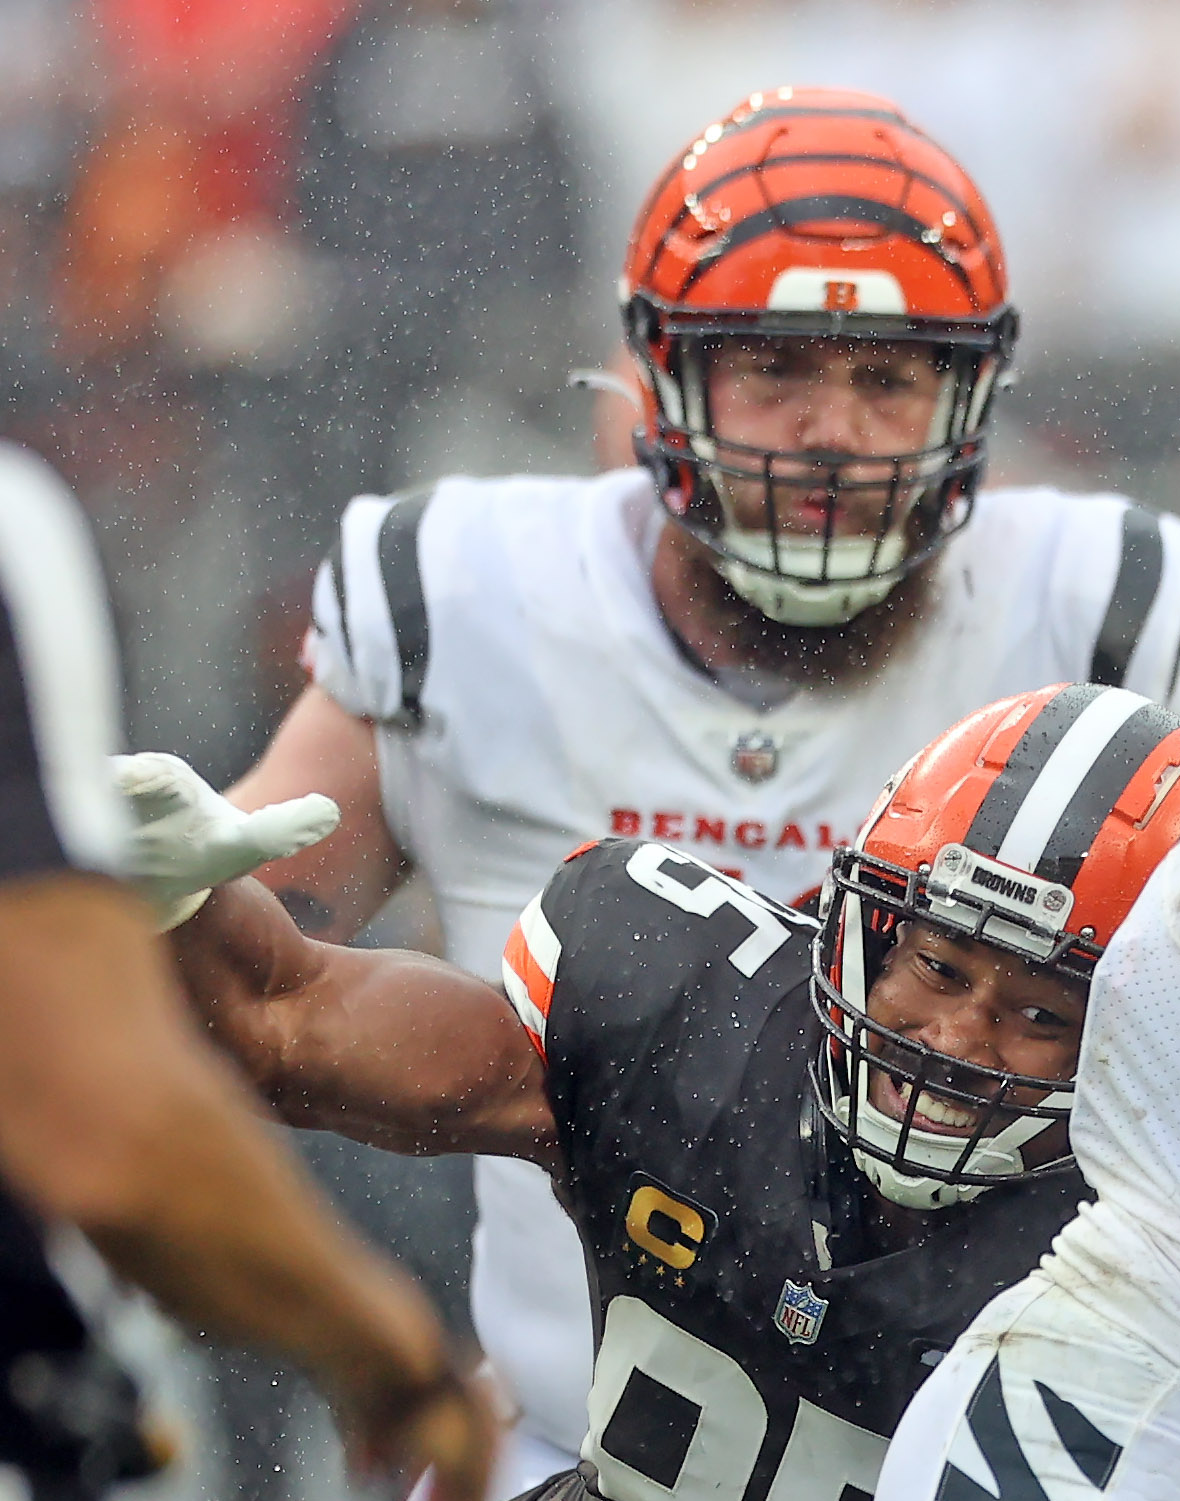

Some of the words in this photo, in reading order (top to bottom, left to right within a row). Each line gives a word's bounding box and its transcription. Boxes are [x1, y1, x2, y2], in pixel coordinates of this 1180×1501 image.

[609, 807, 863, 851] BENGAL
[970, 865, 1038, 906] BROWNS
[625, 1186, 705, 1270] C
[780, 1306, 816, 1338] NFL
